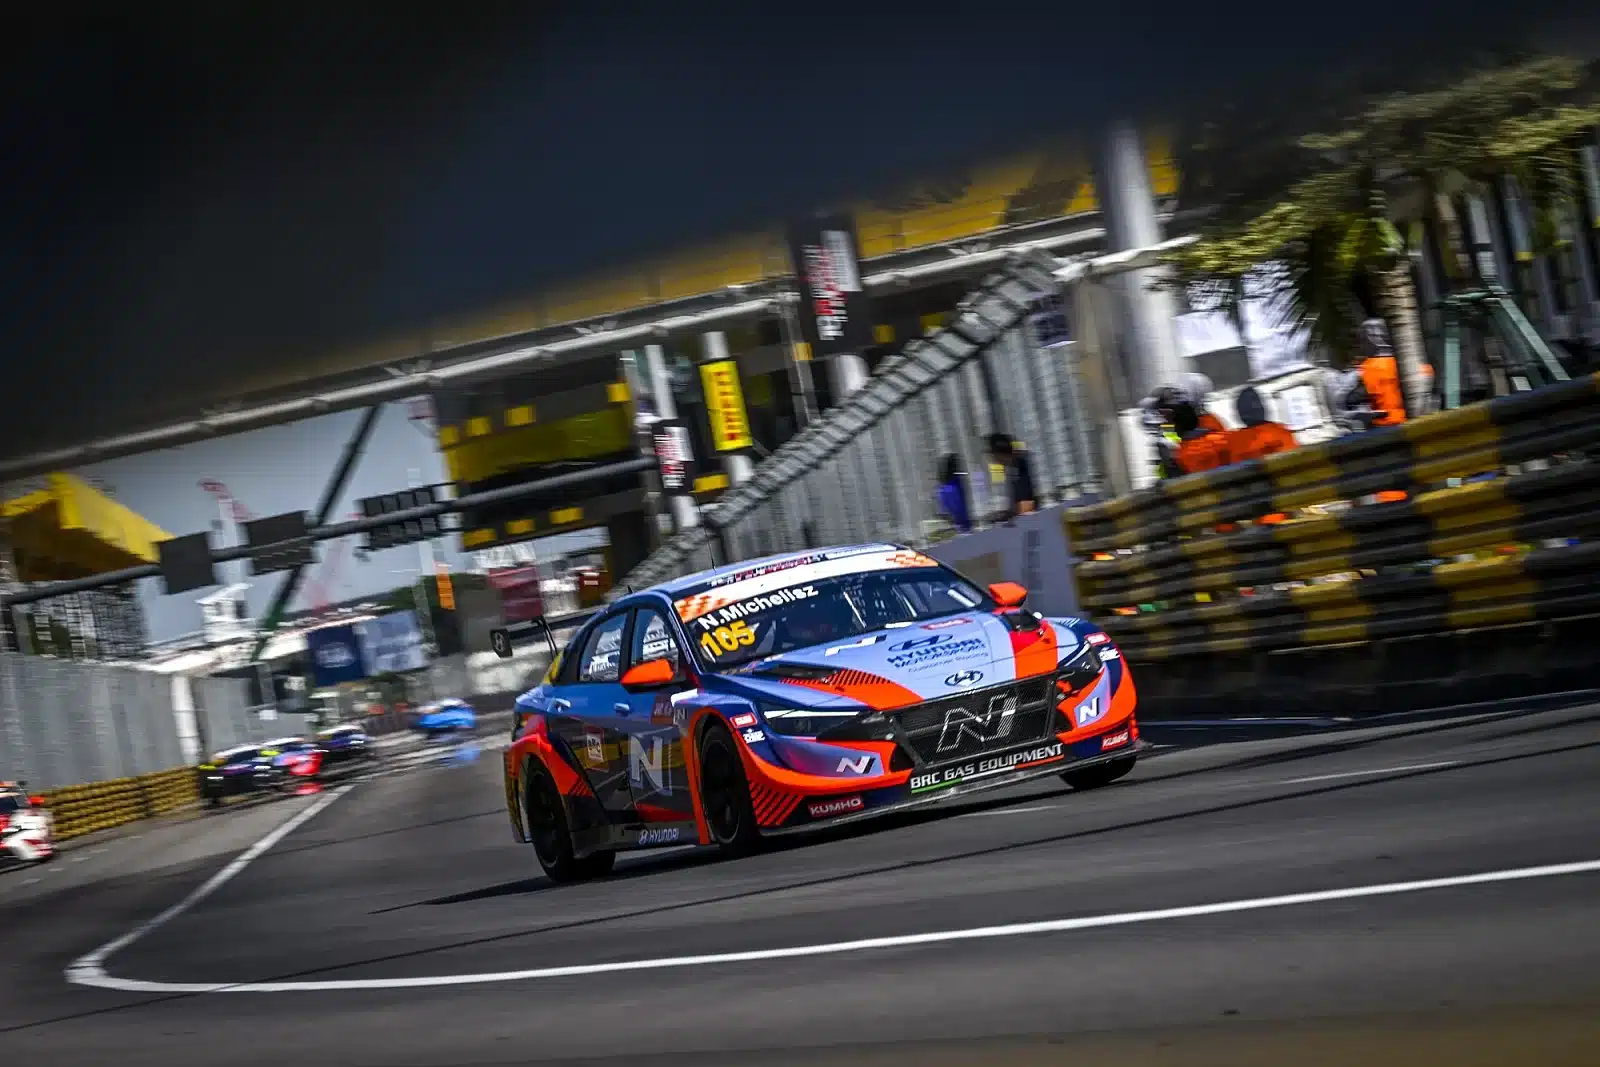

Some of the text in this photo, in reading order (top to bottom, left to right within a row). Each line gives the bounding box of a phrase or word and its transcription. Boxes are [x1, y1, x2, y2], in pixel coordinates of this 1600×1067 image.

[697, 584, 819, 631] N.Michelisz
[700, 619, 757, 658] 105
[886, 637, 983, 665] HYUNDAI
[935, 693, 1018, 753] N
[1079, 697, 1100, 723] N
[628, 733, 673, 797] N
[836, 755, 877, 774] N
[910, 743, 1064, 789] BRC GAS EQUIPMENT
[809, 797, 862, 816] KUMHO
[648, 828, 680, 842] HYUNDAI
